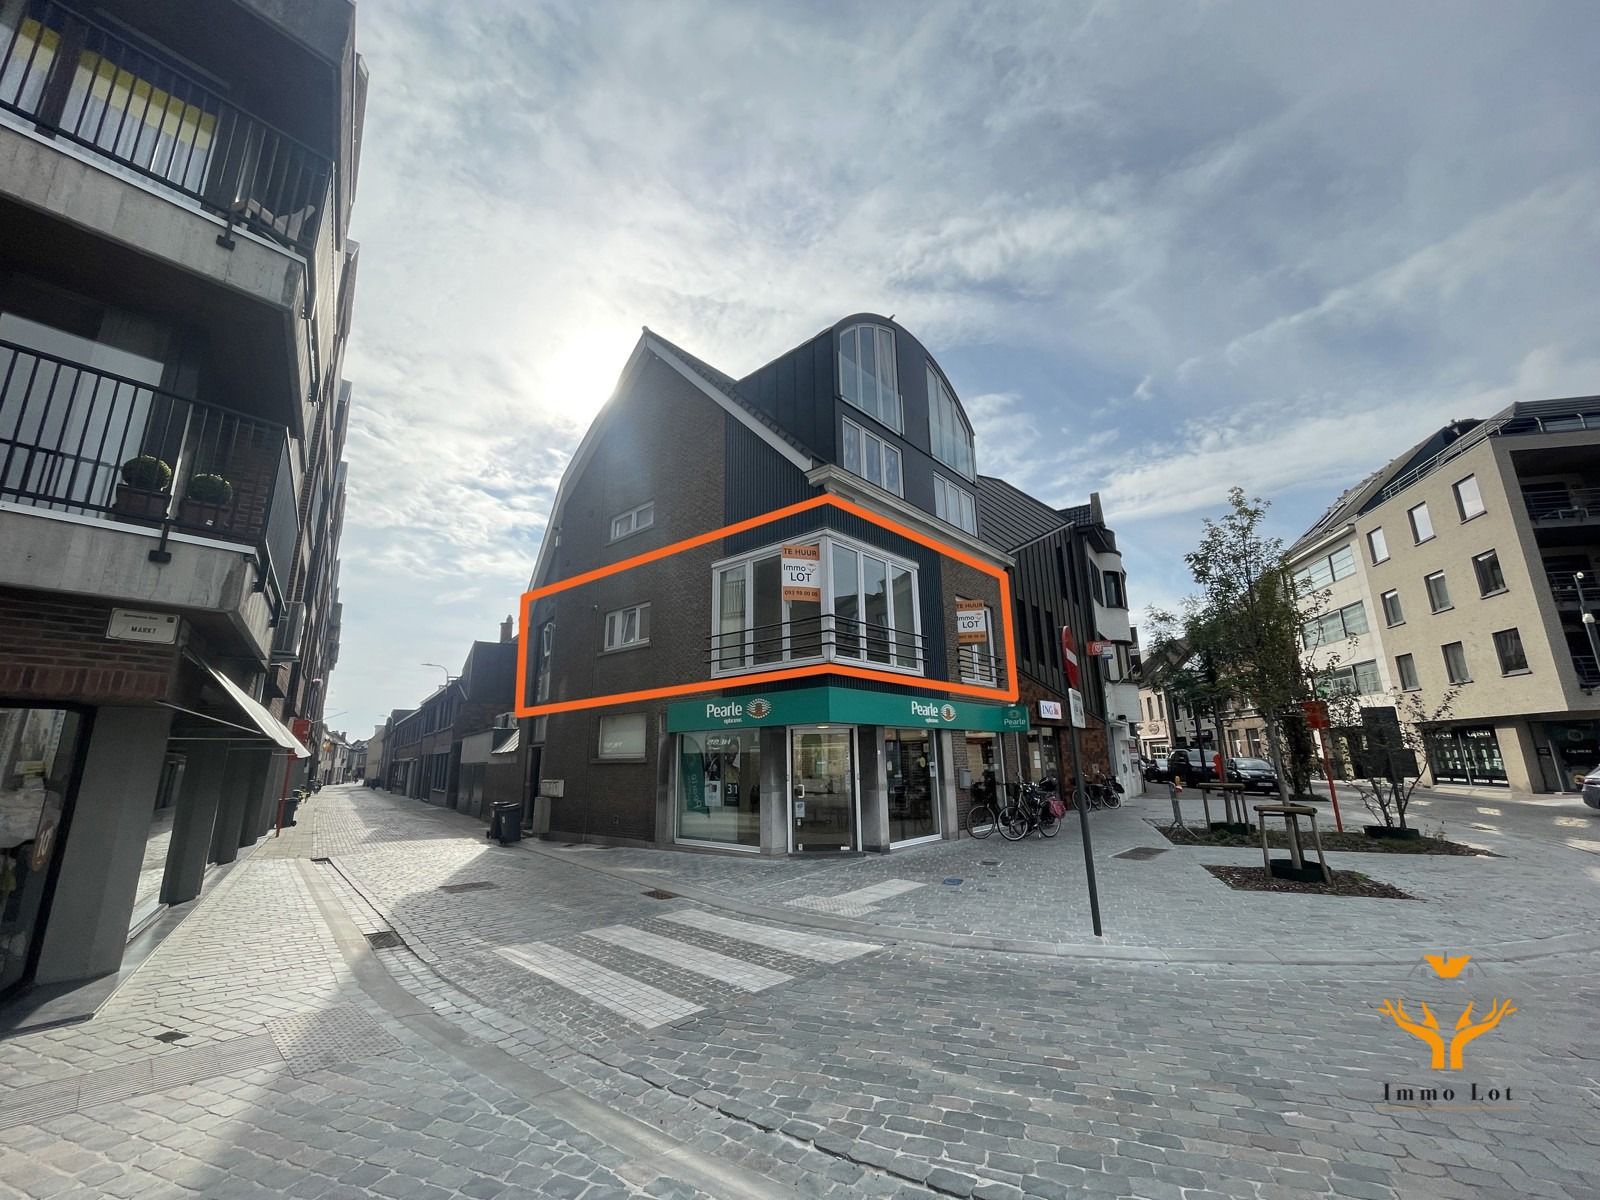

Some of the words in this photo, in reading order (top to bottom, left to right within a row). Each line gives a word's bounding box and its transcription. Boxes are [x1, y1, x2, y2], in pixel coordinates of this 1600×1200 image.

[795, 549, 817, 557] HUUR
[783, 563, 806, 572] Immo
[790, 572, 812, 582] LOT
[131, 625, 157, 634] MARKT
[962, 621, 980, 629] LOT
[706, 701, 743, 718] Pearle
[911, 700, 939, 717] Pearle
[1042, 704, 1054, 715] ING
[1003, 718, 1026, 726] Pearle
